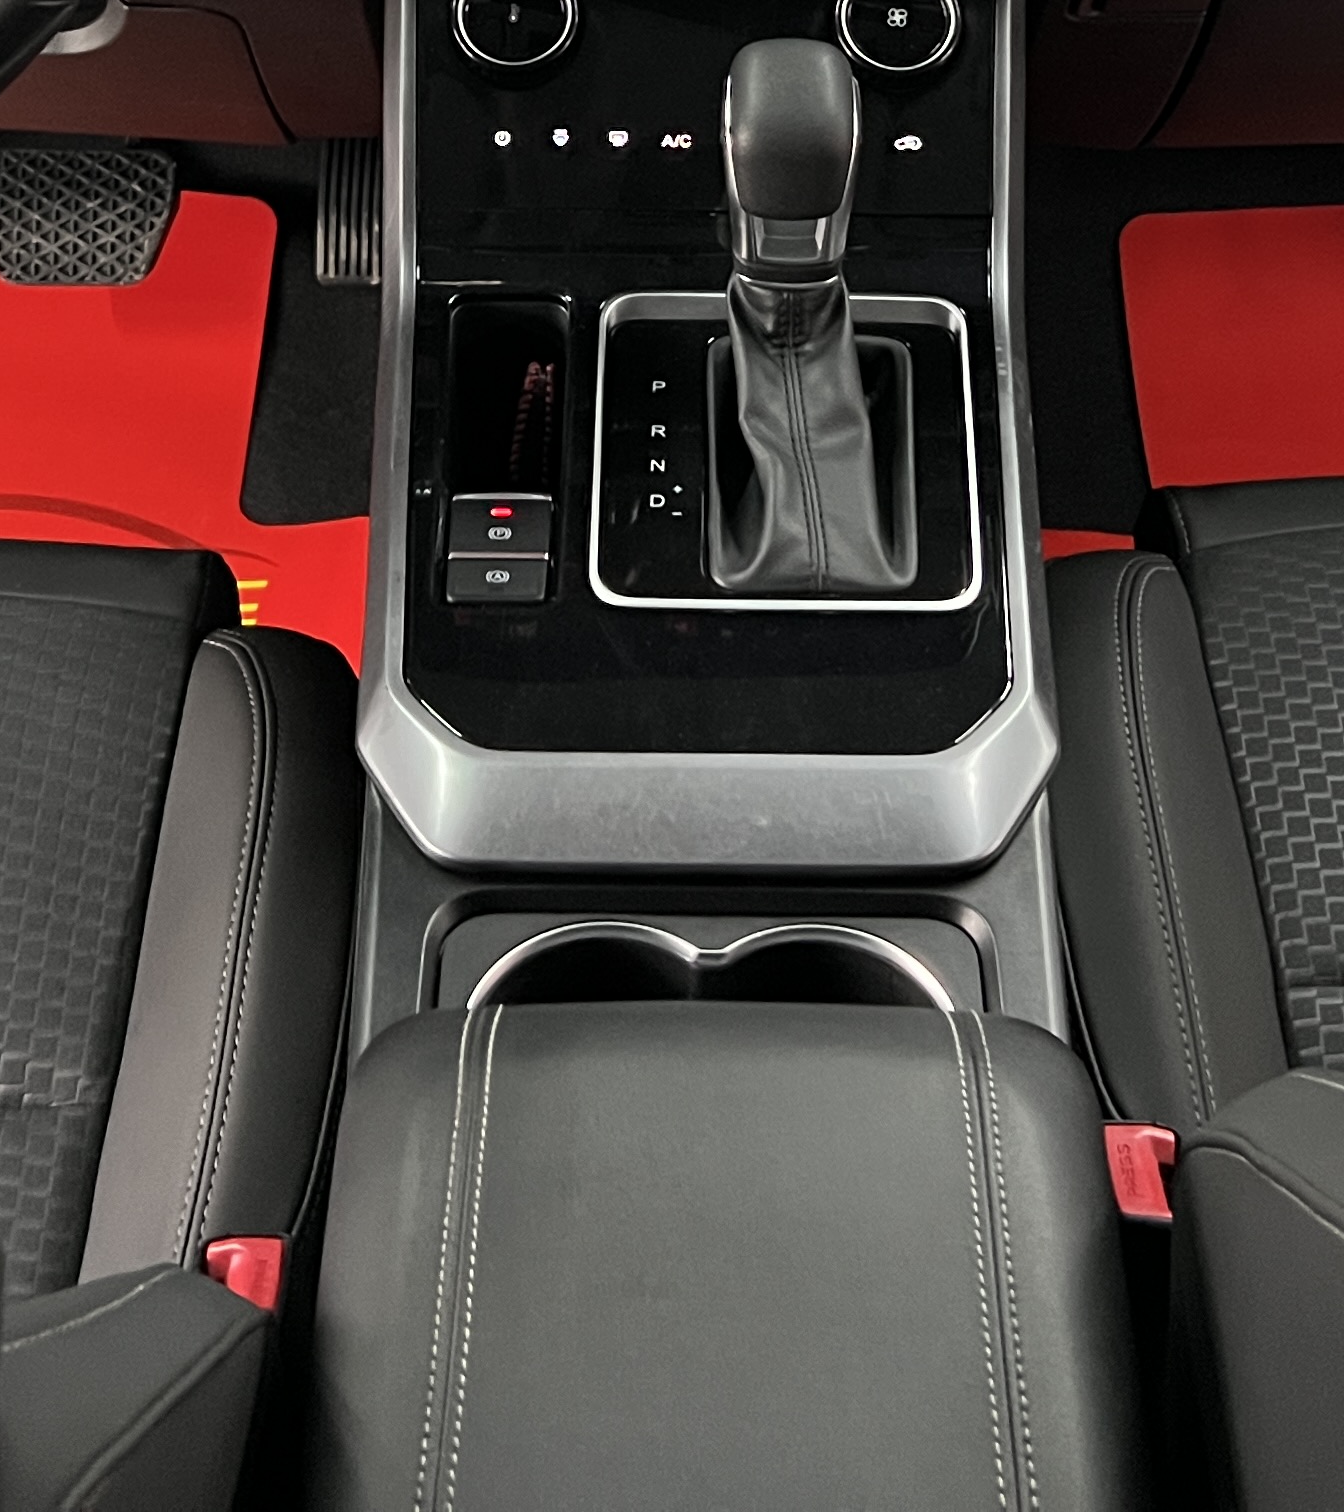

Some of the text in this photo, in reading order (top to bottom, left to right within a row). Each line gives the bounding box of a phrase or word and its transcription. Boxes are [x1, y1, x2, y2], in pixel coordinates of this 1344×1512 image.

[660, 133, 693, 149] A/C
[652, 380, 667, 393] P
[651, 424, 666, 438] R
[650, 459, 666, 472] N
[649, 493, 666, 508] D
